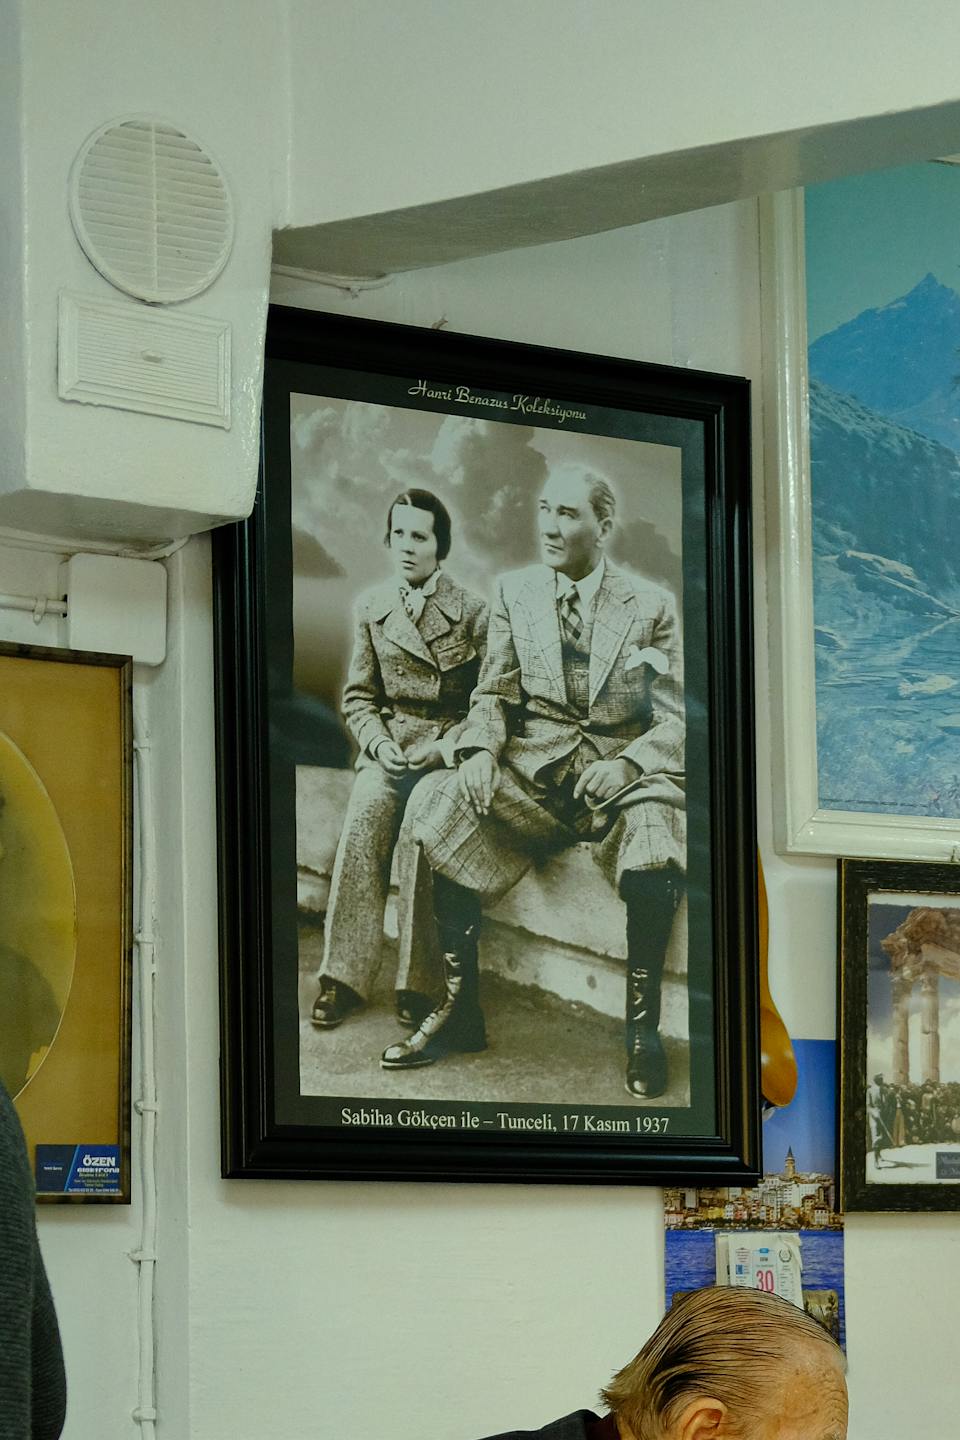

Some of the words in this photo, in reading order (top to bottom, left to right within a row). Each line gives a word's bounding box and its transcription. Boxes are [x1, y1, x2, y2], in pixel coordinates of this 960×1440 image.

[408, 379, 452, 401] Hanri
[454, 386, 509, 409] Benazus
[510, 394, 587, 424] Koleksiyonu
[341, 1107, 394, 1126] Sabiha
[397, 1109, 456, 1130] Gökçen
[461, 1111, 480, 1128] ile
[497, 1112, 558, 1132] Tunceli,
[563, 1114, 580, 1130] 17
[584, 1115, 631, 1132] Kasım
[635, 1117, 670, 1133] 1937
[82, 1154, 116, 1167] ÖZEN
[756, 1270, 775, 1292] 30
